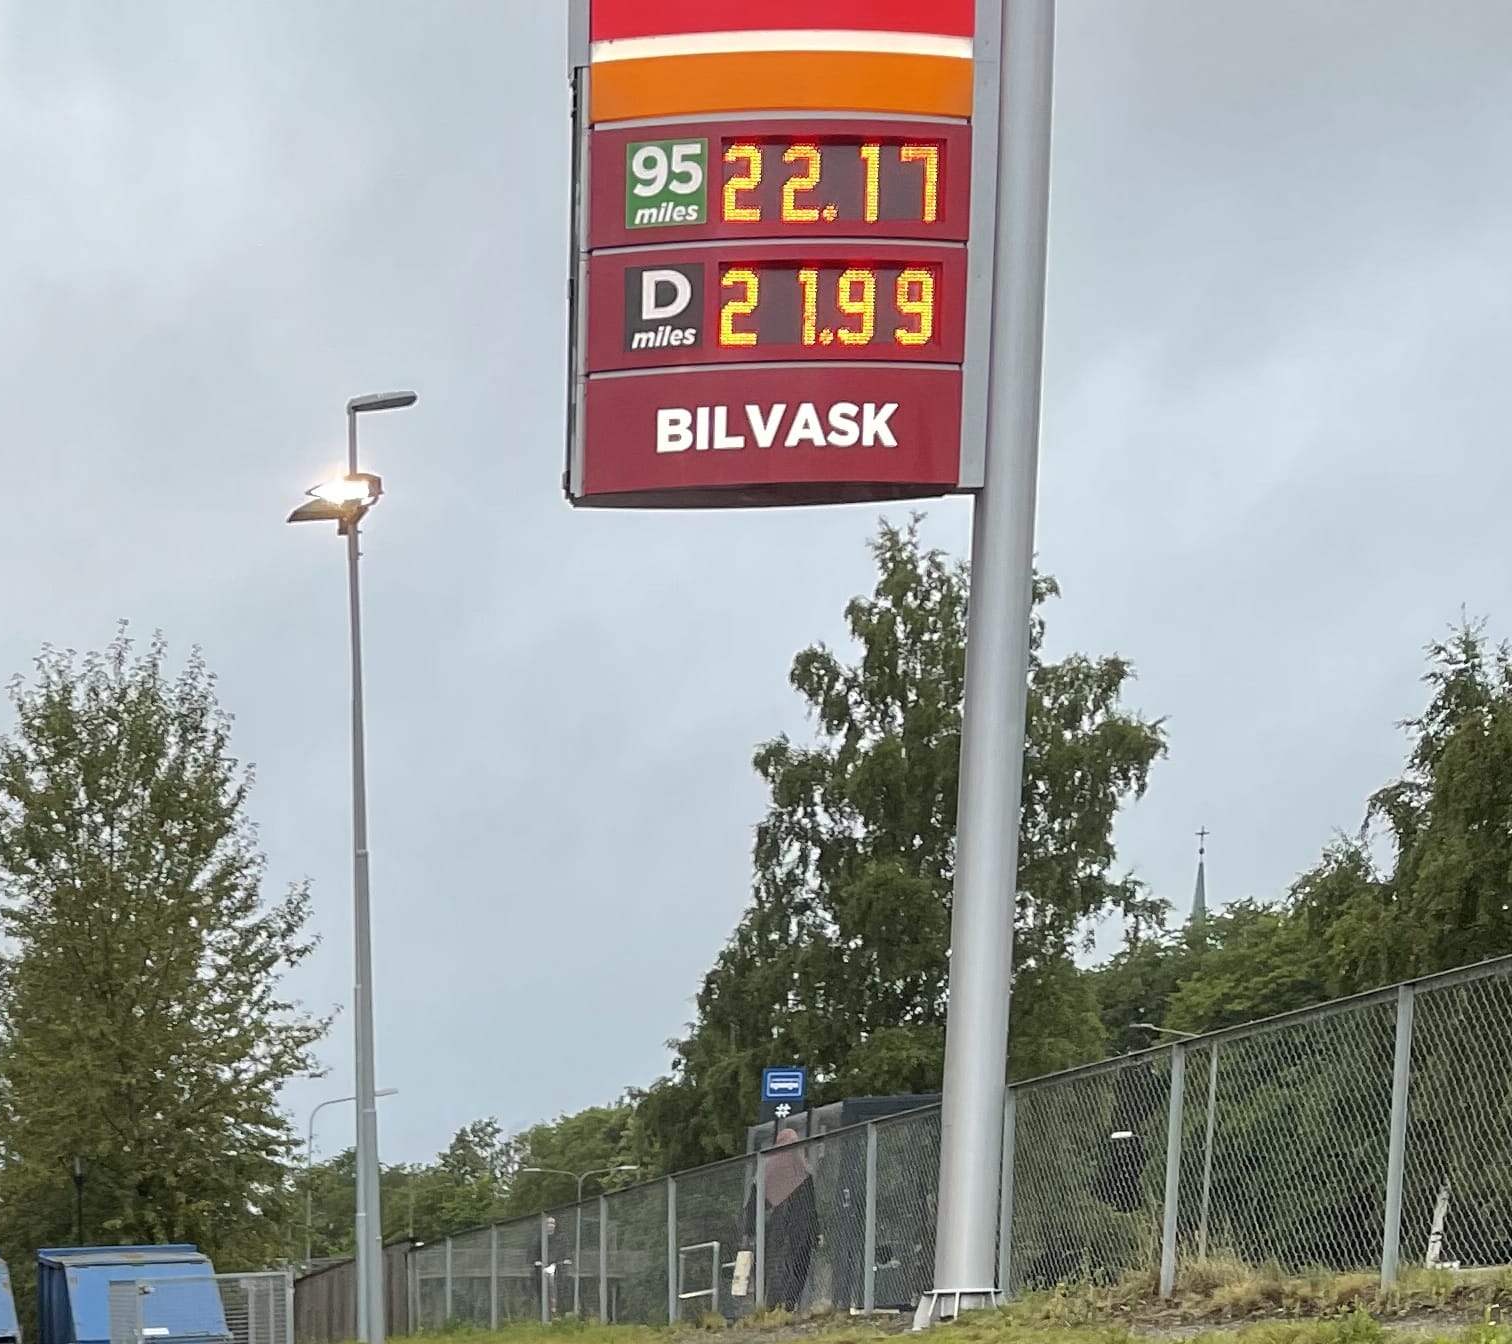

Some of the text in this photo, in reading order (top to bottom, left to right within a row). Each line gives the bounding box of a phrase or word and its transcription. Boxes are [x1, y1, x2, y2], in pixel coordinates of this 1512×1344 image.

[632, 143, 703, 197] 95
[723, 142, 939, 223] 22.17
[634, 202, 699, 225] miles
[641, 270, 692, 320] D
[719, 267, 935, 346] 21.99
[631, 326, 697, 349] miles
[656, 403, 899, 453] BILVASK
